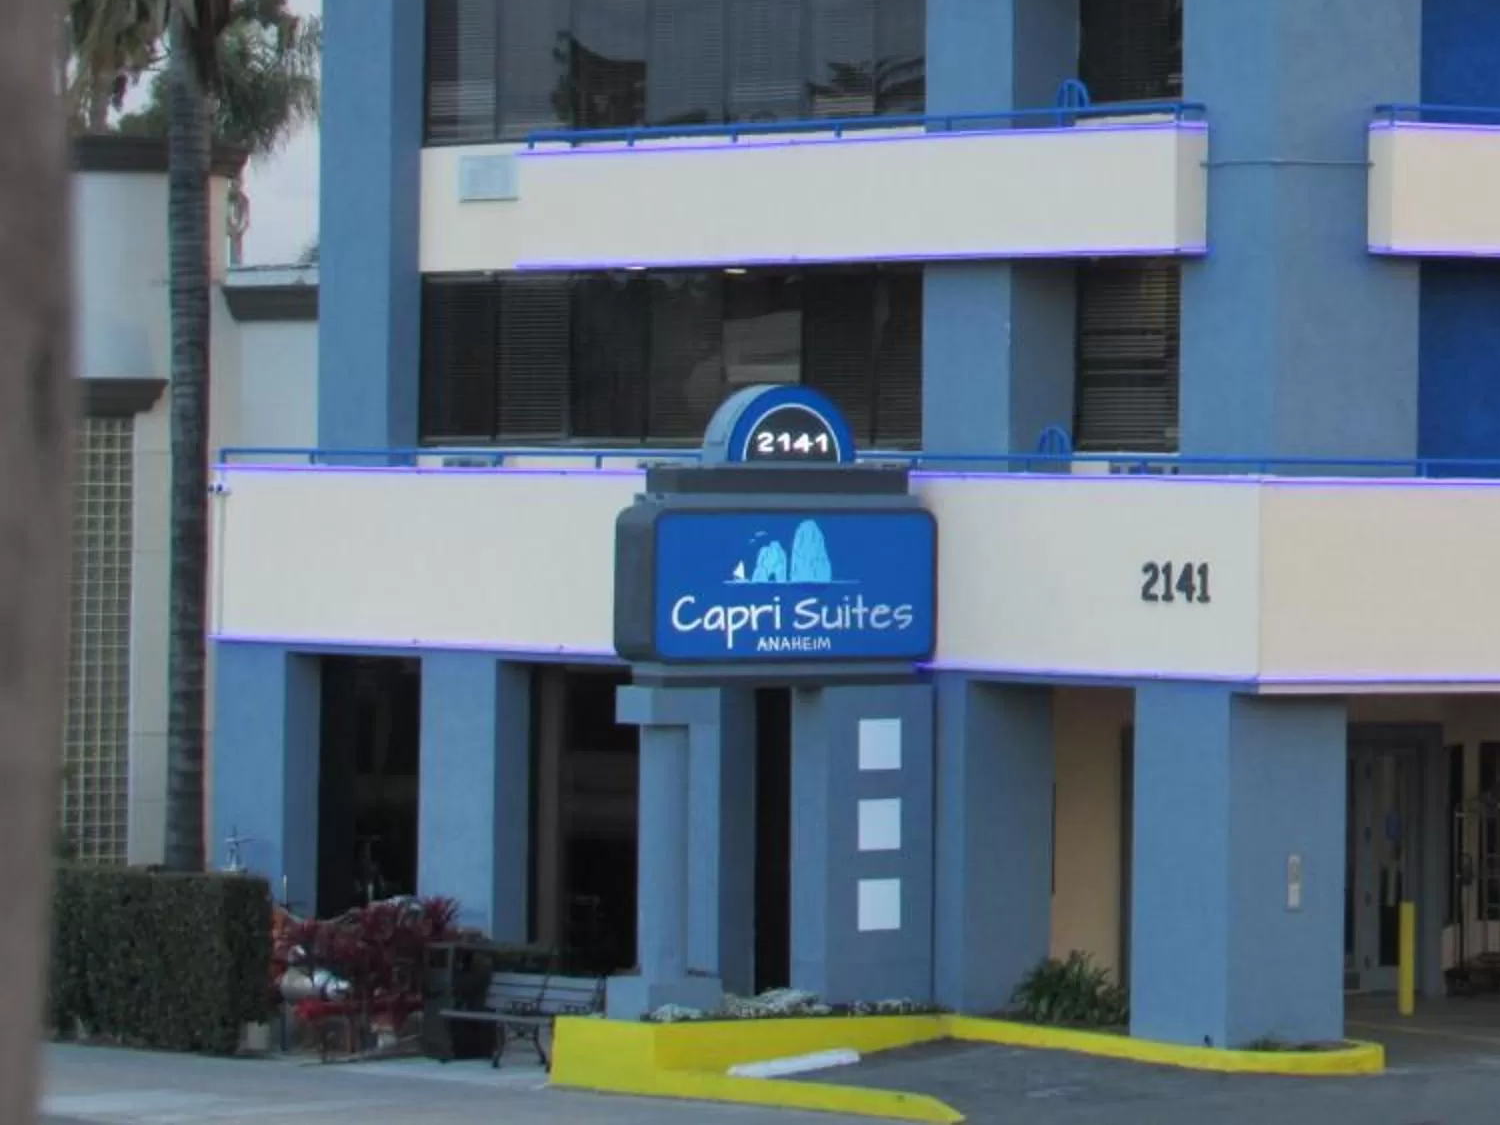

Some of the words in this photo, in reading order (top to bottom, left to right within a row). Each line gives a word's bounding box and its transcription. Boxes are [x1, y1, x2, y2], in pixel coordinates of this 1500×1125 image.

[756, 431, 830, 453] 2141
[1141, 560, 1212, 603] 2141
[671, 595, 781, 649] Capri
[792, 594, 914, 630] Suites
[756, 636, 832, 652] ANAHEIM
